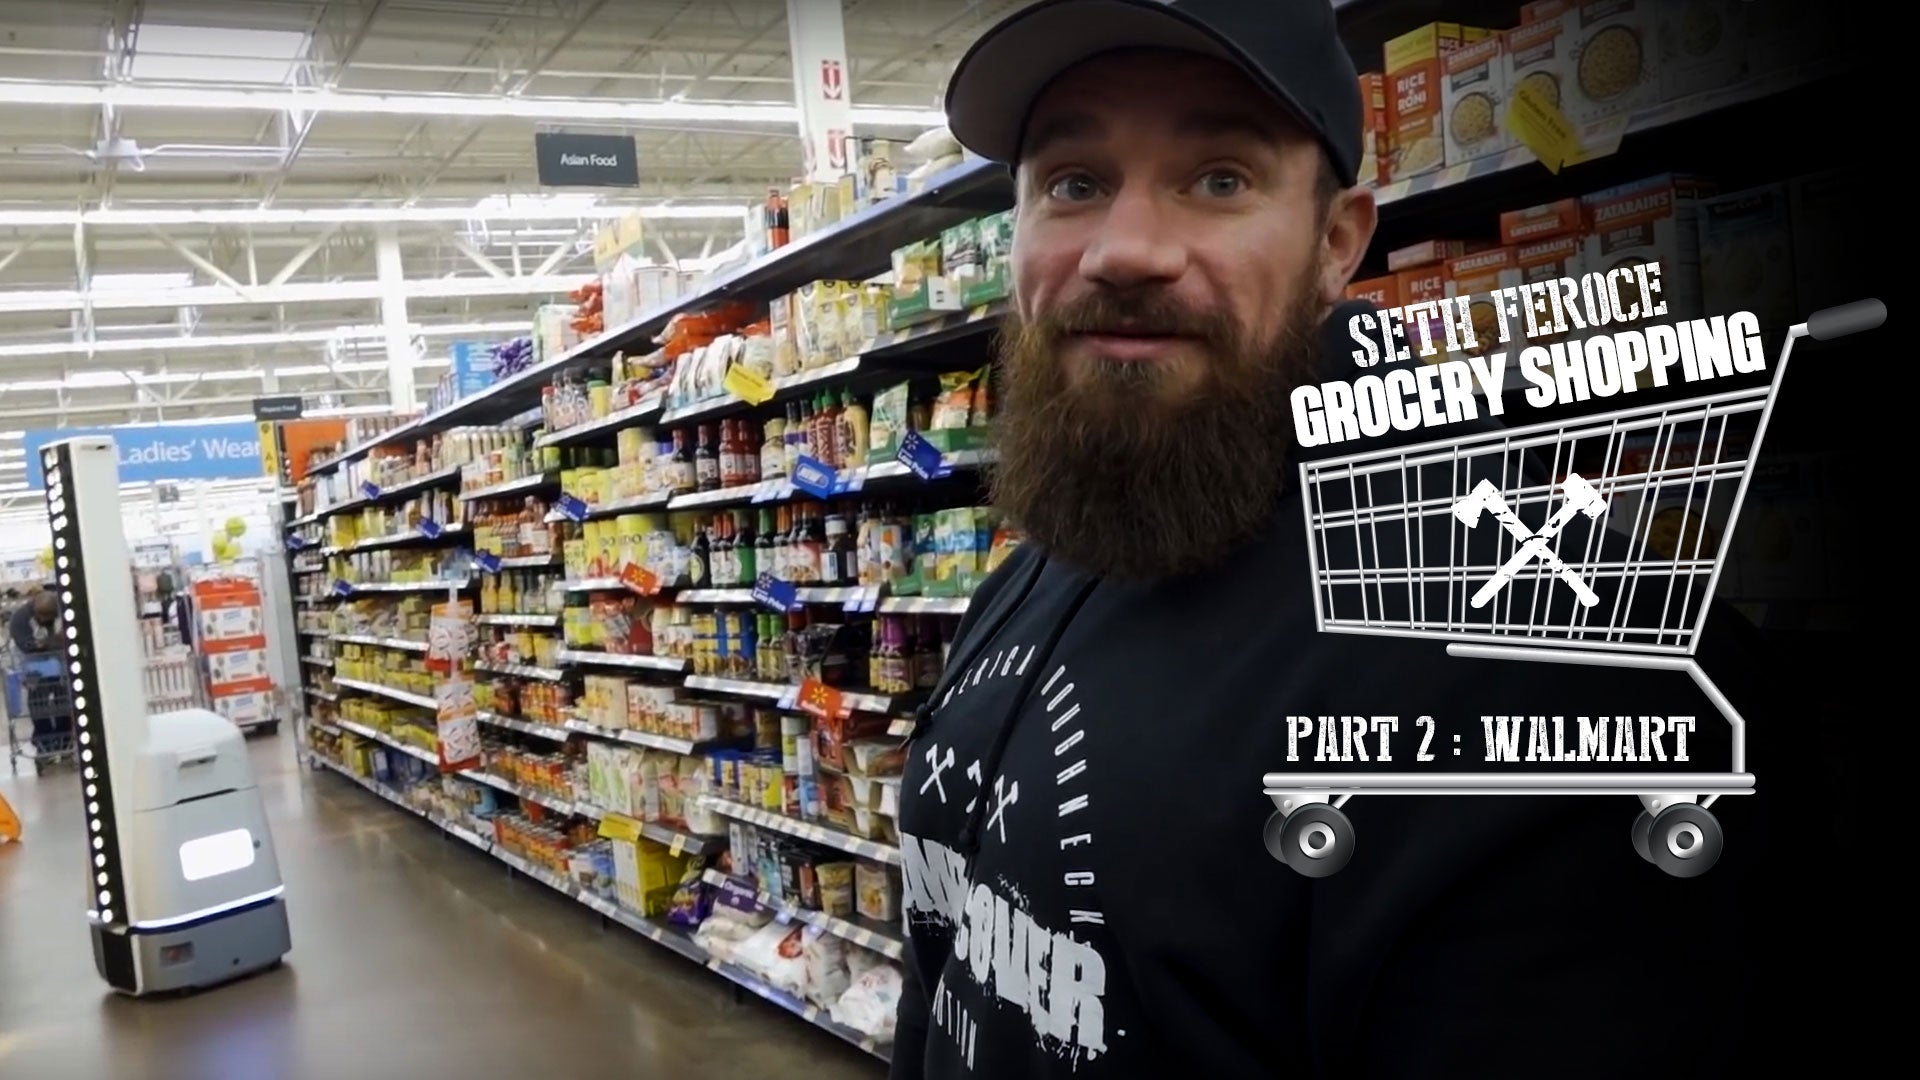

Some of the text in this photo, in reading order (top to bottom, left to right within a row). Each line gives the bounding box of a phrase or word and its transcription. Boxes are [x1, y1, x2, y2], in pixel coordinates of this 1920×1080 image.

[1396, 72, 1427, 92] RICE
[1397, 90, 1428, 113] RONI
[560, 153, 618, 167] Asian Food
[1410, 276, 1442, 292] RICE
[202, 437, 261, 460] Wear
